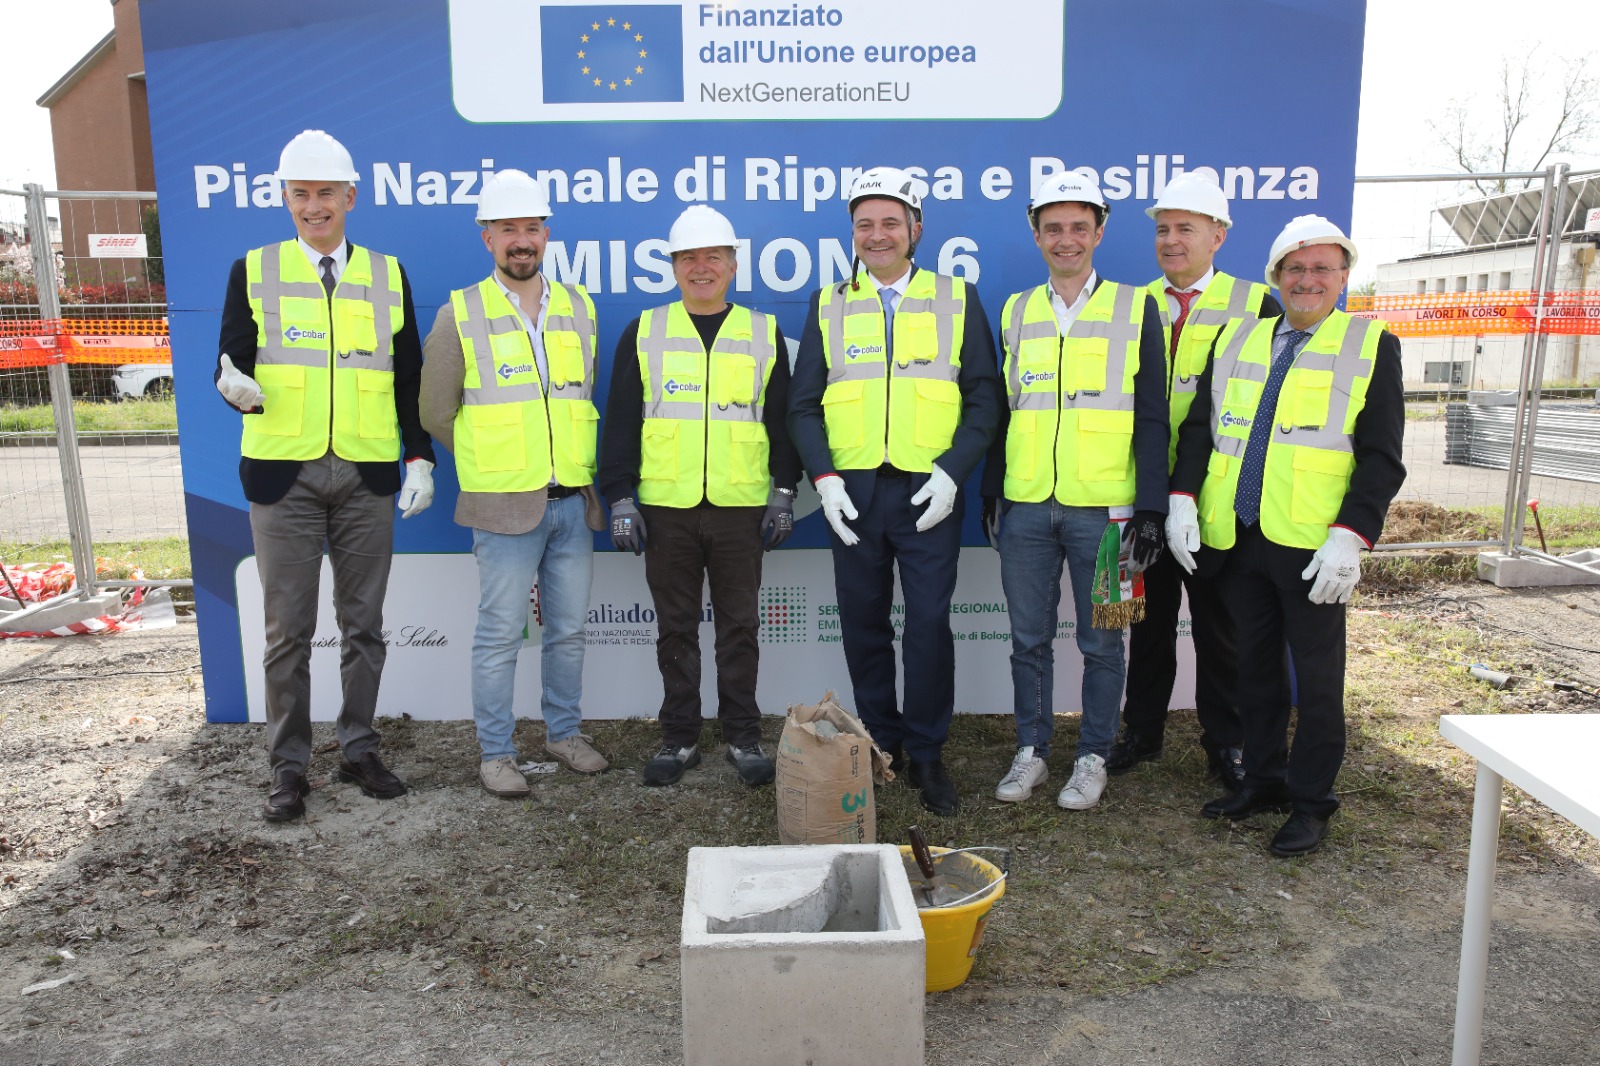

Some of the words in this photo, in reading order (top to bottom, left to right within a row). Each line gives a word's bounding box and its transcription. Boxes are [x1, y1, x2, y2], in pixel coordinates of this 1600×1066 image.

[699, 3, 843, 27] Finanziato
[699, 40, 855, 63] dall'Unione
[864, 44, 976, 68] europea
[700, 81, 910, 102] NextGenerationEU
[194, 162, 284, 208] Pia
[373, 156, 659, 206] Nazinale
[673, 155, 726, 203] di
[745, 155, 964, 212] Riprsa
[979, 166, 1013, 201] e
[543, 237, 872, 294] MISION
[937, 236, 981, 285] 6
[1416, 308, 1454, 320] LAVORI
[1457, 308, 1469, 319] IN
[1472, 307, 1507, 318] CORSO
[1545, 307, 1575, 317] LAVORI
[1576, 307, 1587, 317] IN
[302, 329, 326, 340] cobar
[861, 345, 882, 354] cobar
[1035, 371, 1056, 381] cobar
[680, 382, 702, 392] cobar
[948, 603, 1008, 614] REGIONAL
[395, 625, 449, 647] Salute
[602, 629, 651, 637] NAZIONALE
[968, 632, 978, 640] di
[842, 787, 867, 814] 3
